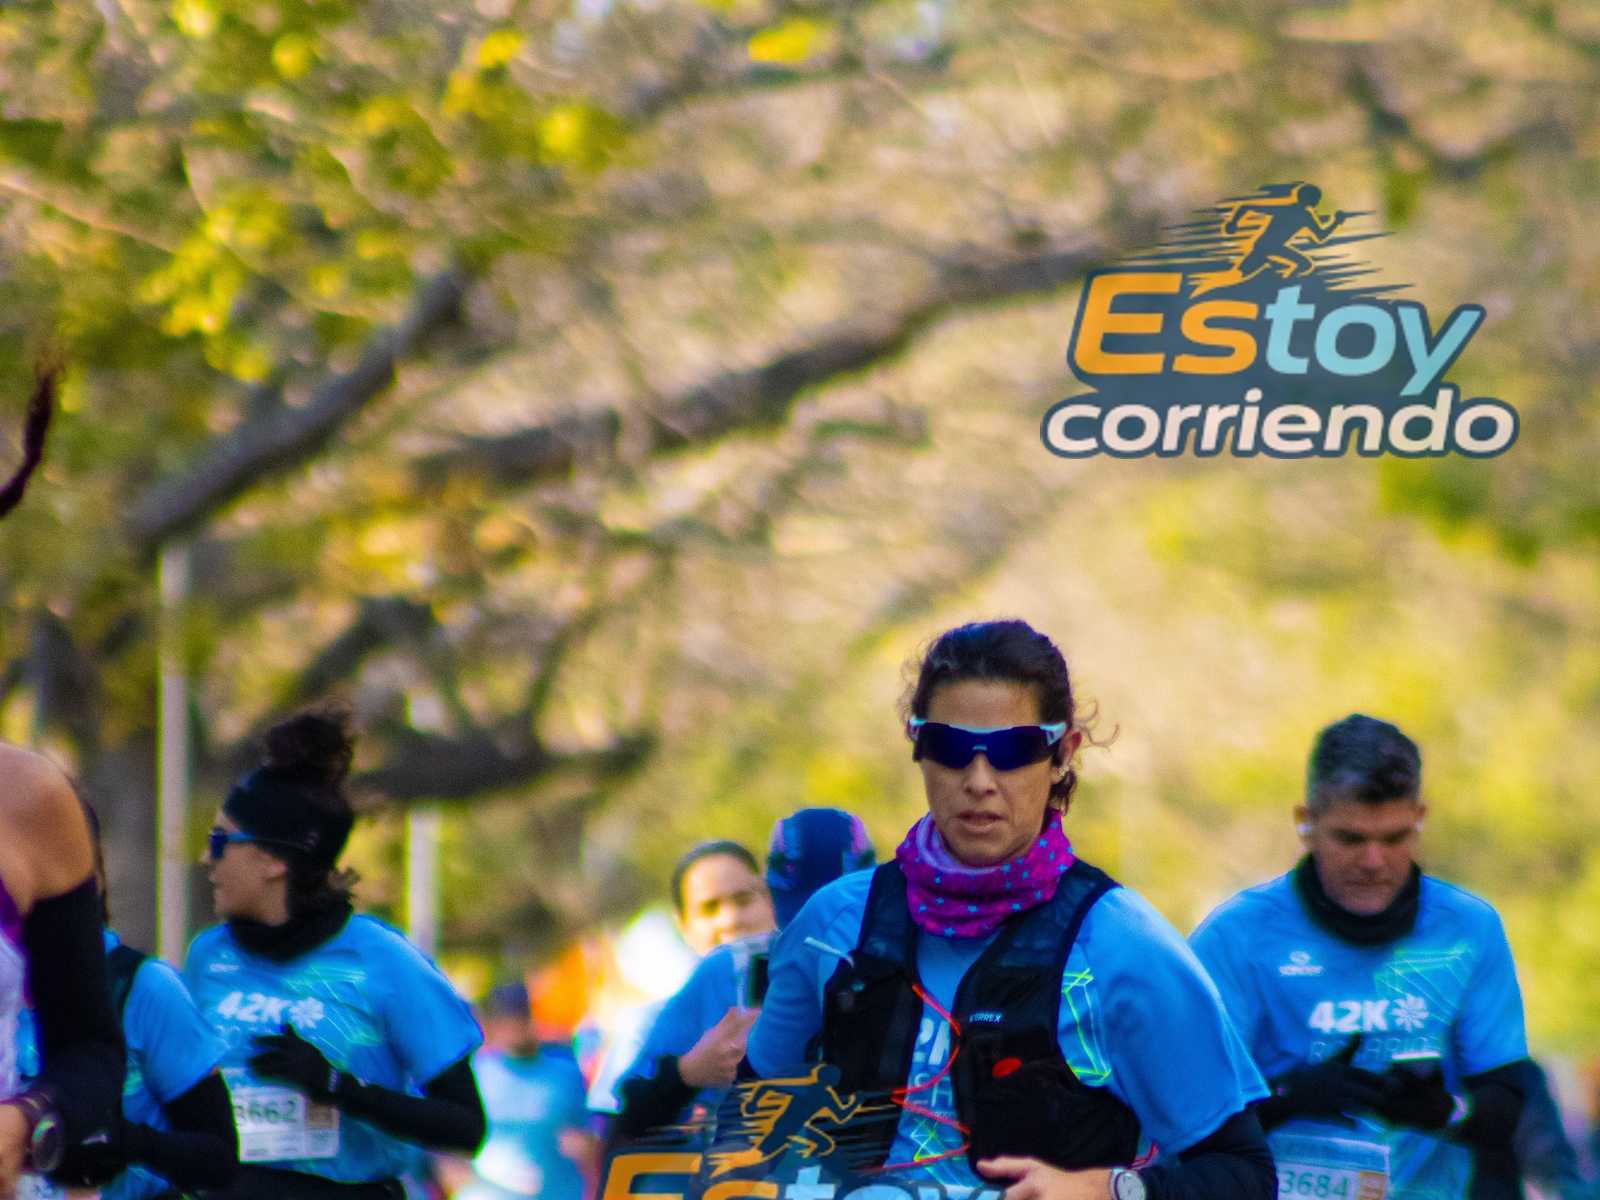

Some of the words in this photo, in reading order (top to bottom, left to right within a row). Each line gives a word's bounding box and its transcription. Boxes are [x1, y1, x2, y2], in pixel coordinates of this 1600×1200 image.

[216, 992, 292, 1023] 42K
[1309, 1001, 1389, 1033] 42K
[1279, 1170, 1349, 1200] 3684
